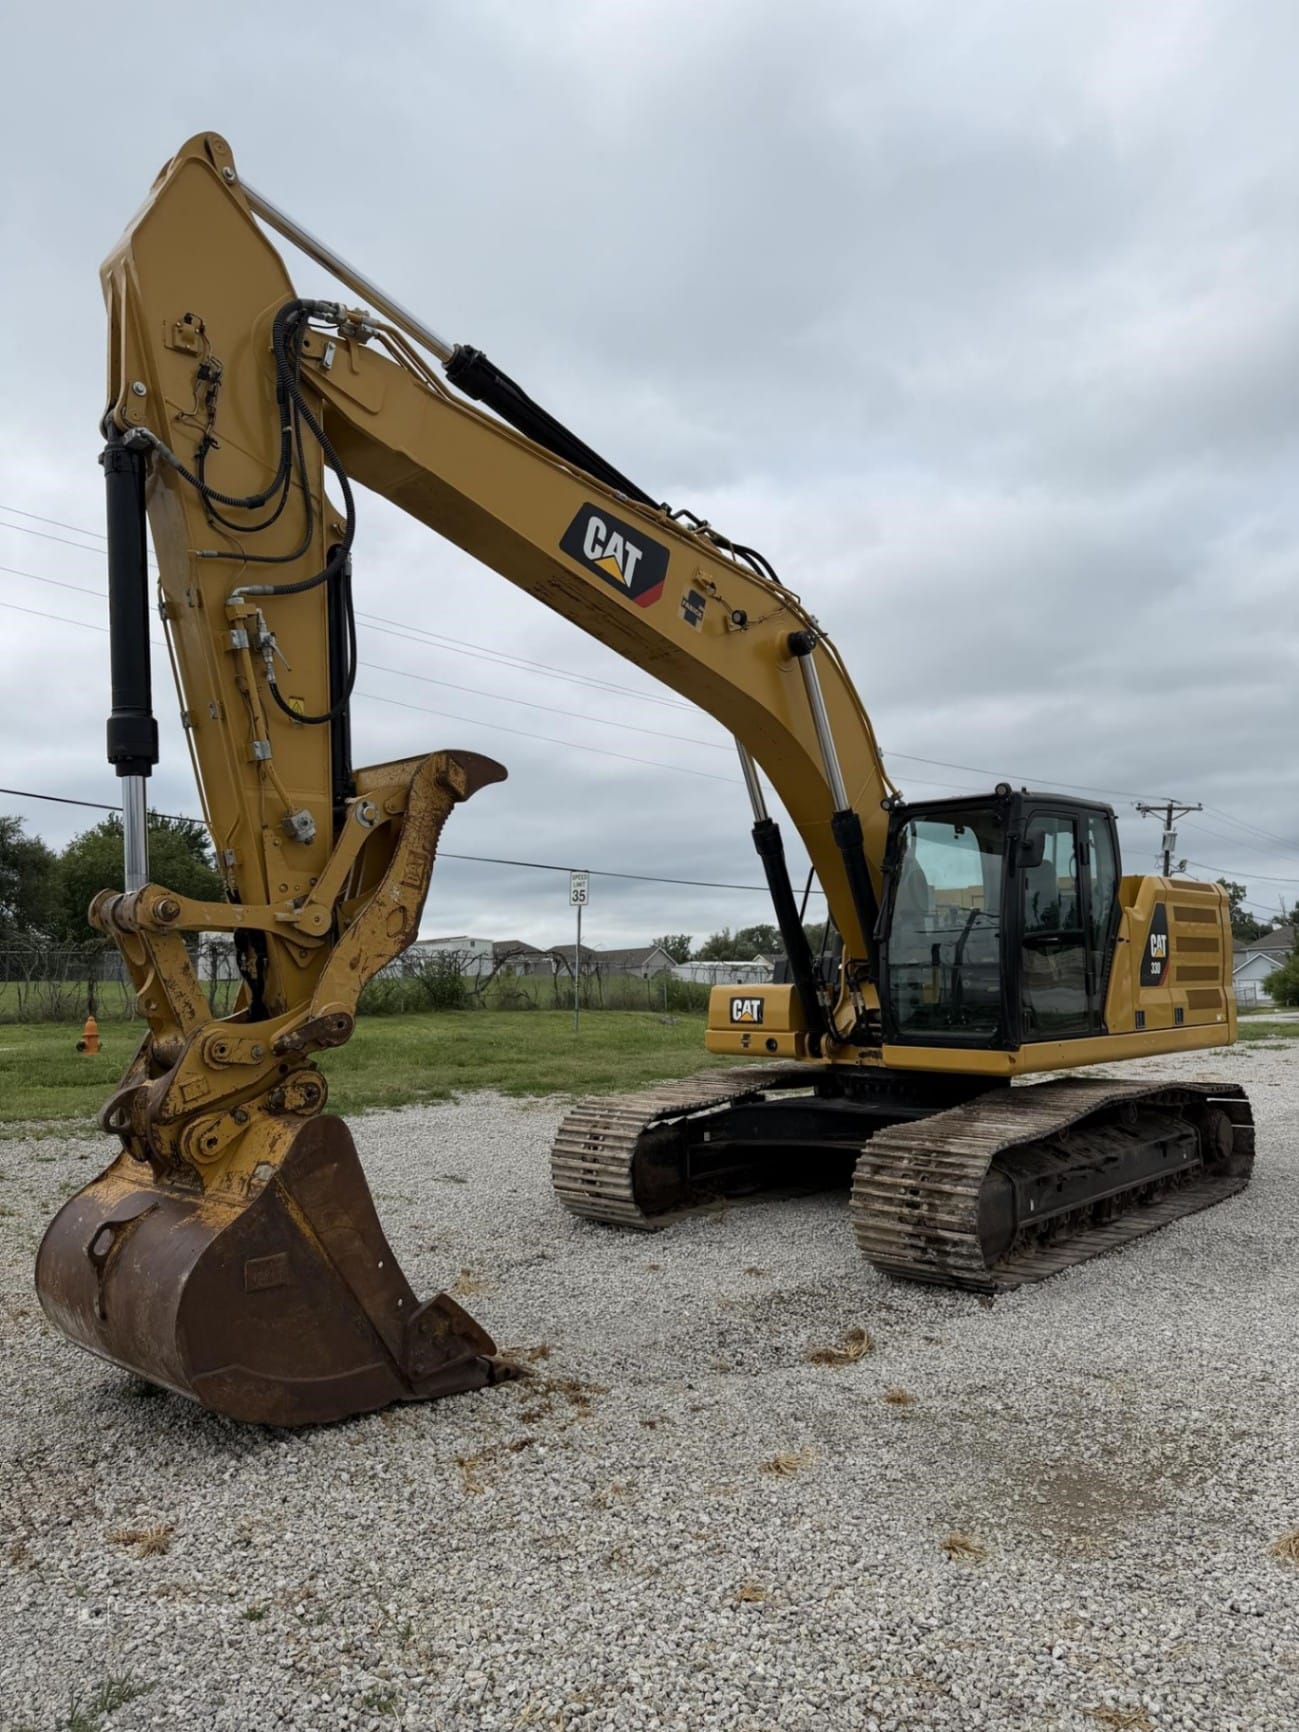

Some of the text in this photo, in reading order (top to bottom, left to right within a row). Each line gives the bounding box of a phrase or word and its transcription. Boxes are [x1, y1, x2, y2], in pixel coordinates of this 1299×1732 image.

[583, 516, 643, 588] CAT
[572, 889, 586, 902] 35
[1150, 934, 1167, 957] CAT
[1151, 962, 1161, 974] 330
[732, 999, 760, 1021] CAT
